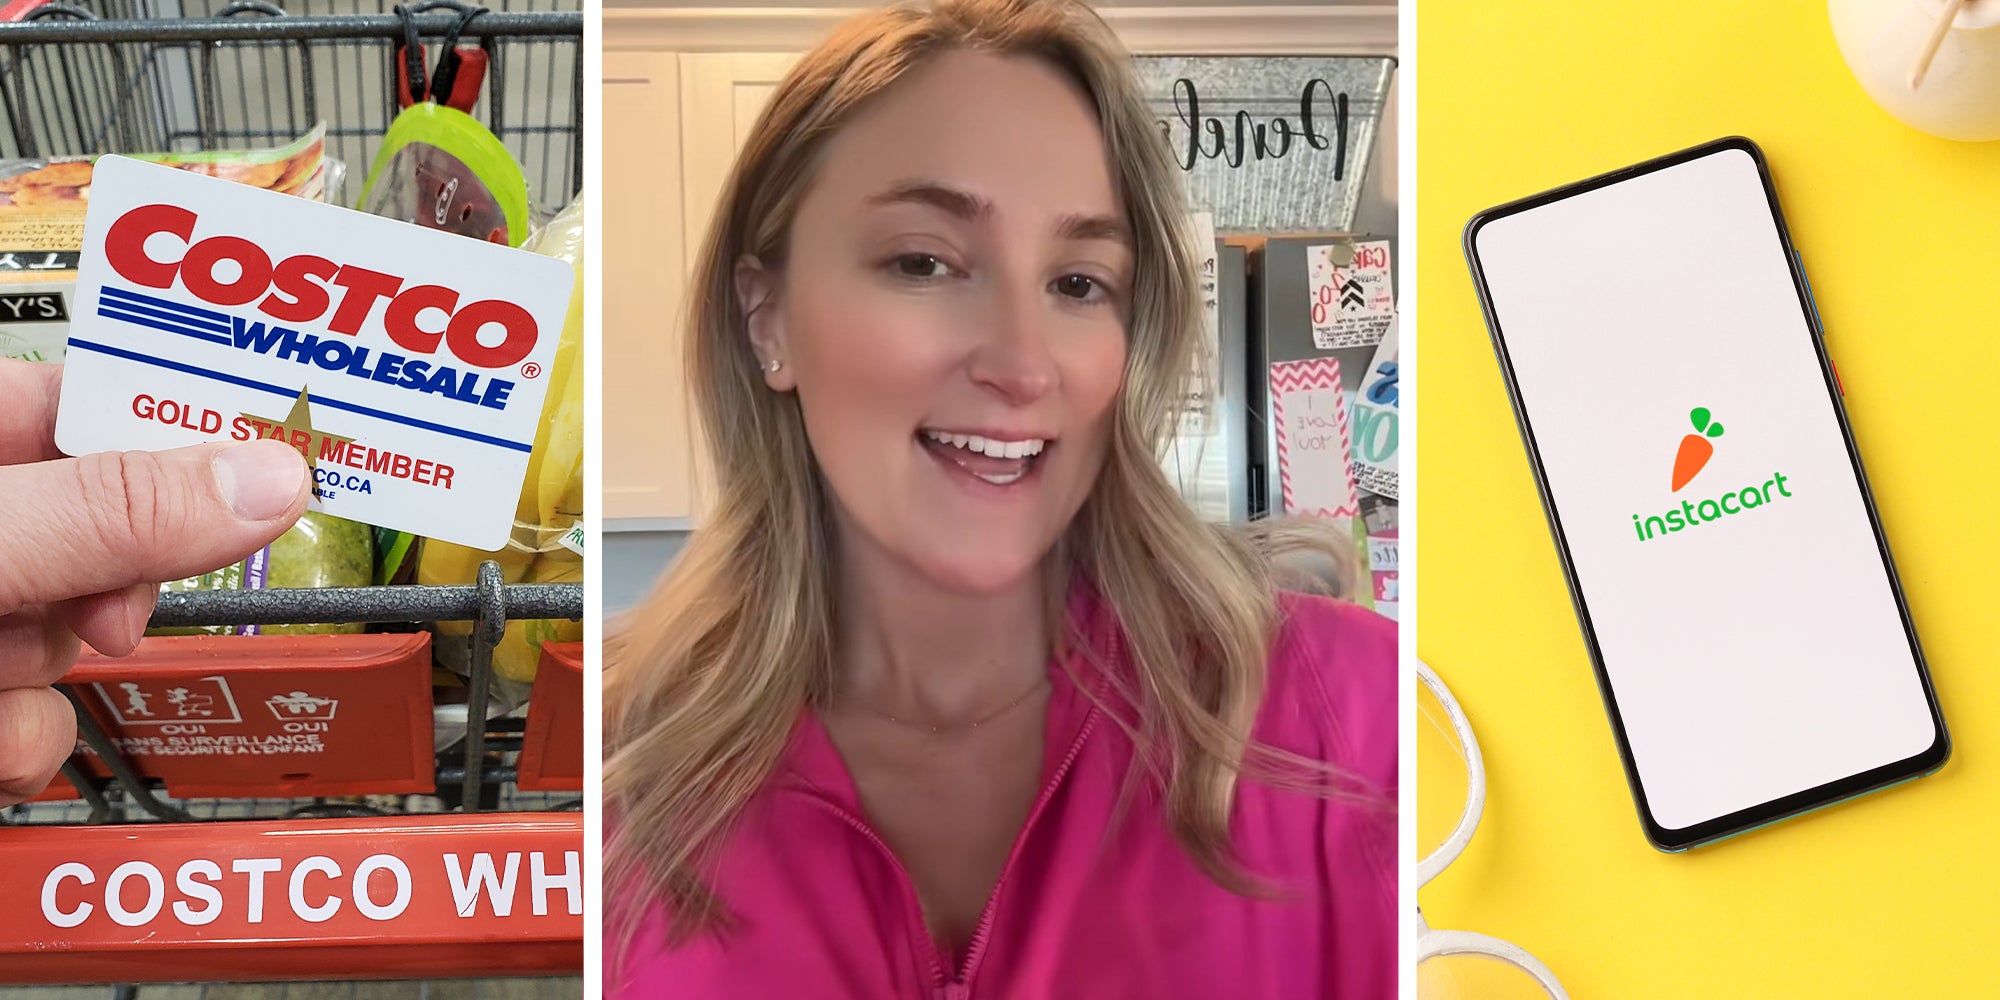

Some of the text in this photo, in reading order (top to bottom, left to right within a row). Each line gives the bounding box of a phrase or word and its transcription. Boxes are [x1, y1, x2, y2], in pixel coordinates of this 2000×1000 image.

[105, 203, 539, 369] COSTCO
[232, 315, 515, 411] WHOLESALE
[132, 394, 455, 490] GOLD STAR MEMBER
[1632, 471, 1792, 542] instacart
[160, 723, 207, 735] OUI
[167, 734, 320, 746] SURVEILLANCE
[283, 722, 329, 732] OUI
[40, 850, 584, 928] COSTCO WH
